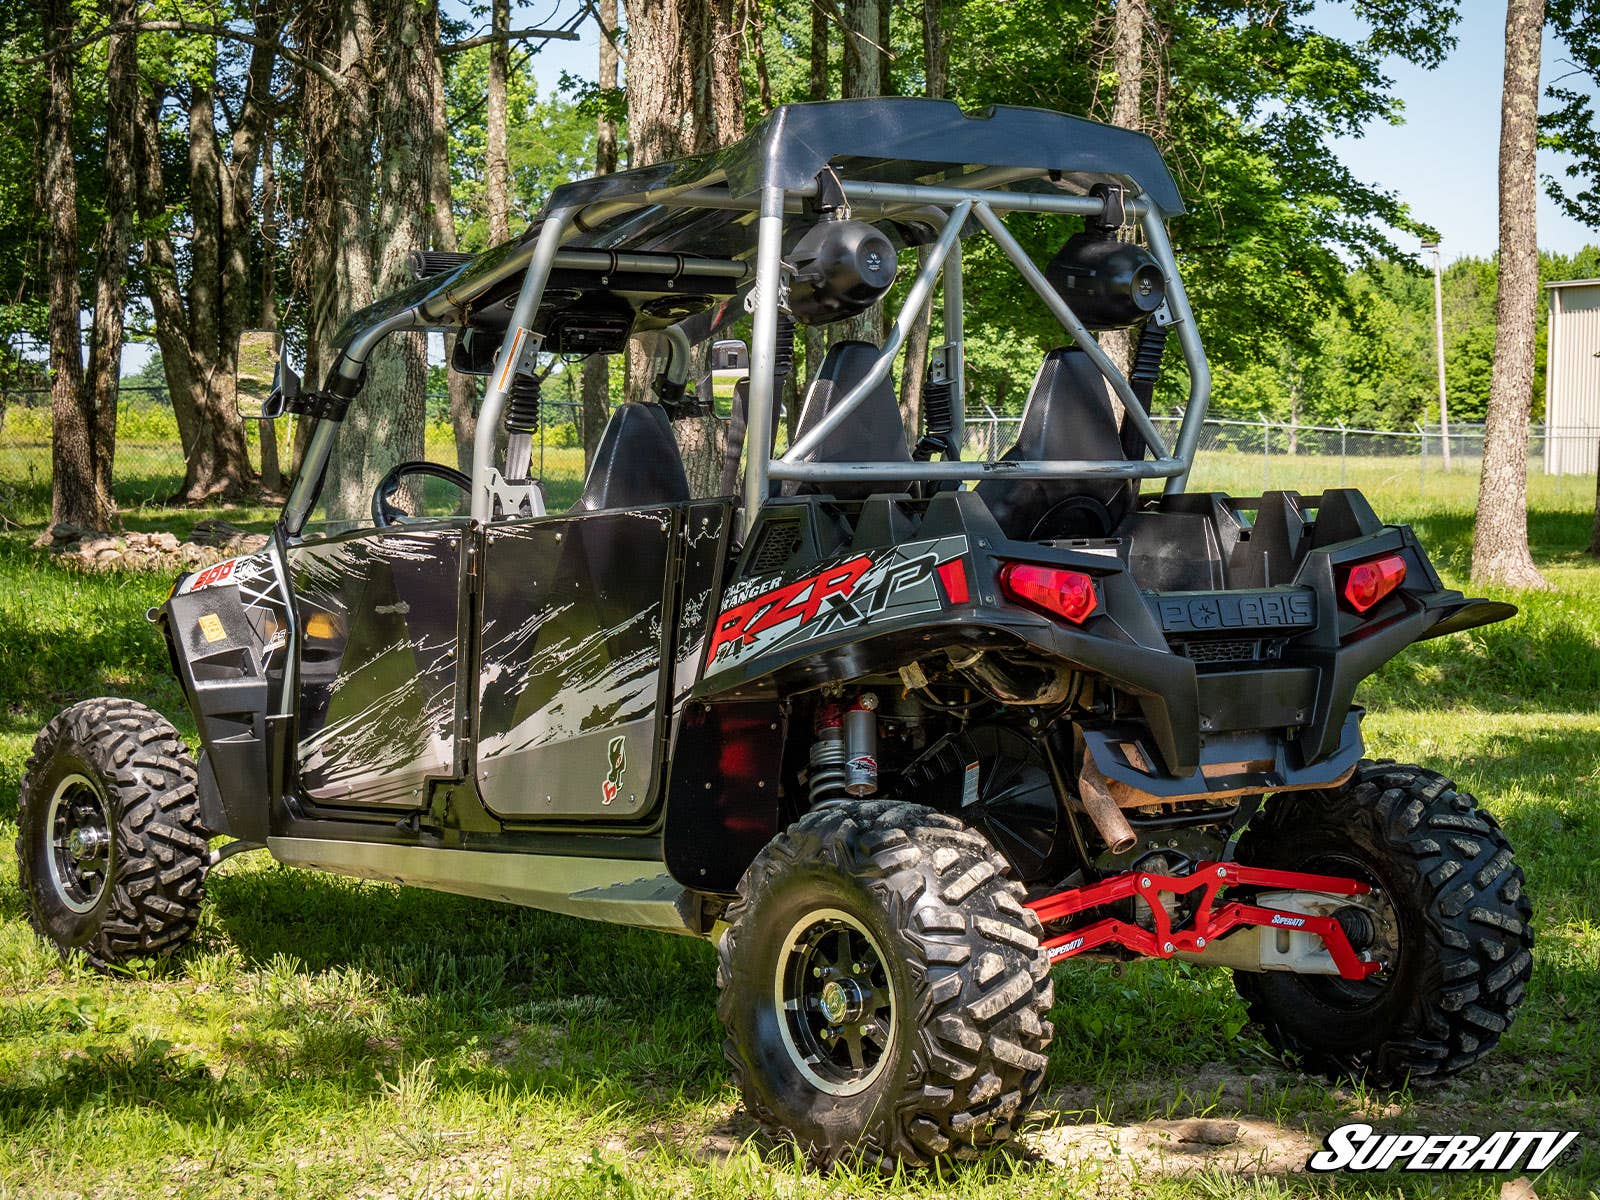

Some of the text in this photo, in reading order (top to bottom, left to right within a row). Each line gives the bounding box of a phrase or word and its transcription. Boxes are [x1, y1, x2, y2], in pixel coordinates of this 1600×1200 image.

[706, 552, 939, 671] RZR XP
[1158, 595, 1313, 630] POLARIS
